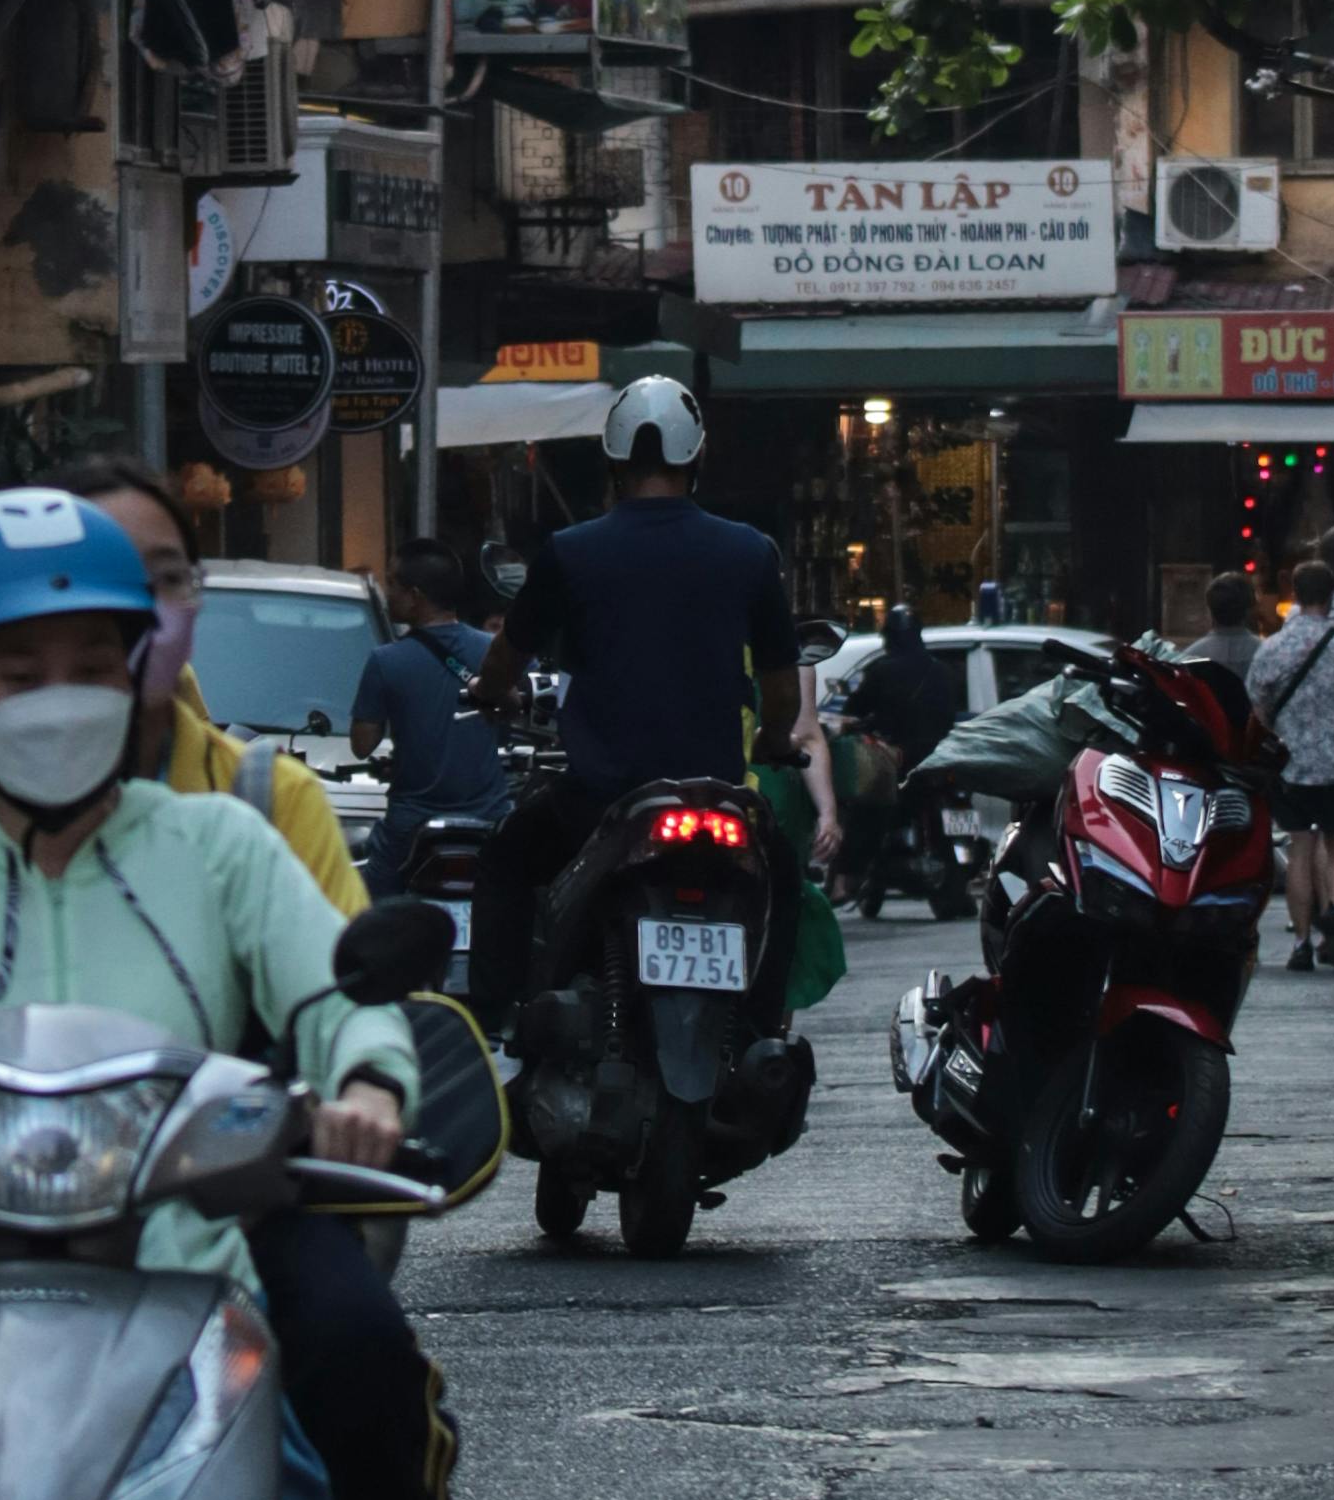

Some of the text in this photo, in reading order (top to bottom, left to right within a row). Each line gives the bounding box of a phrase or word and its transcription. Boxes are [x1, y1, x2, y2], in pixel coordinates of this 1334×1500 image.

[723, 176, 745, 199] 10
[1051, 172, 1074, 192] 10
[805, 173, 1011, 218] TÂN LẬP
[871, 223, 913, 244] PHONG
[1006, 222, 1027, 241] PHI
[201, 211, 231, 300] DISCOVER
[774, 247, 1045, 274] ĐỒ ĐỒNG ĐÀI LOAN
[228, 323, 304, 345] IMPRESSIVE
[1239, 319, 1326, 363] ĐỨC
[271, 353, 309, 375] HOTEL
[311, 355, 322, 376] 2
[655, 924, 728, 956] 89-B1
